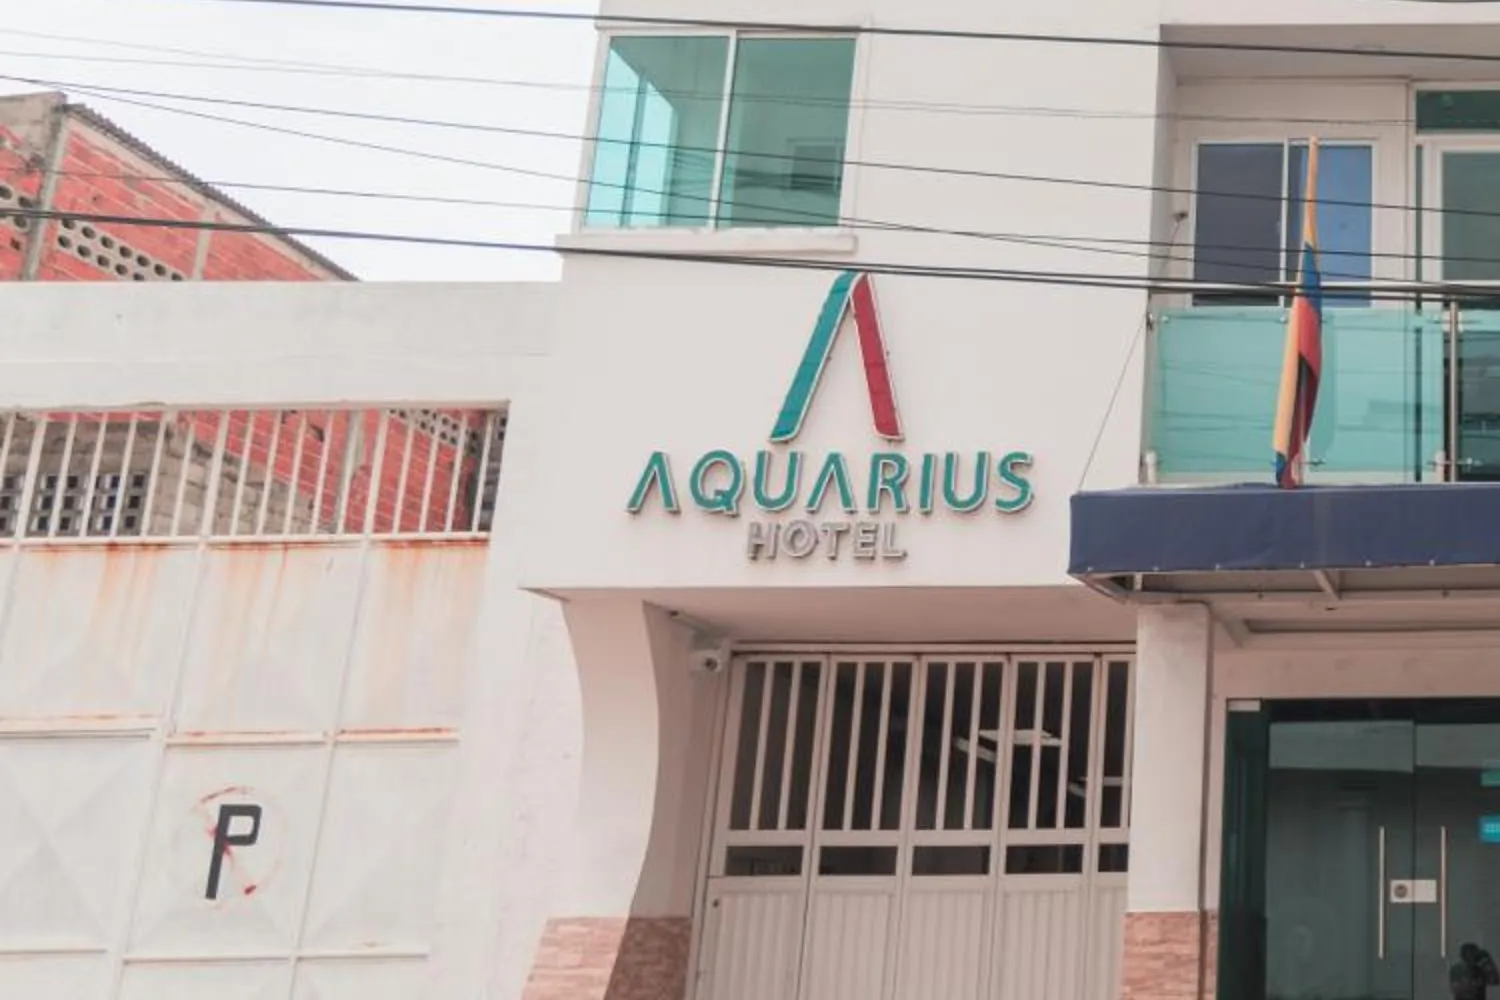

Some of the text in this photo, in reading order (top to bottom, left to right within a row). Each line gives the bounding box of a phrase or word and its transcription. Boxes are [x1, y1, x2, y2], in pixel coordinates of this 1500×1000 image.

[627, 450, 1034, 516] AQUARIUS
[746, 520, 908, 561] HOTEL
[205, 804, 262, 900] P
